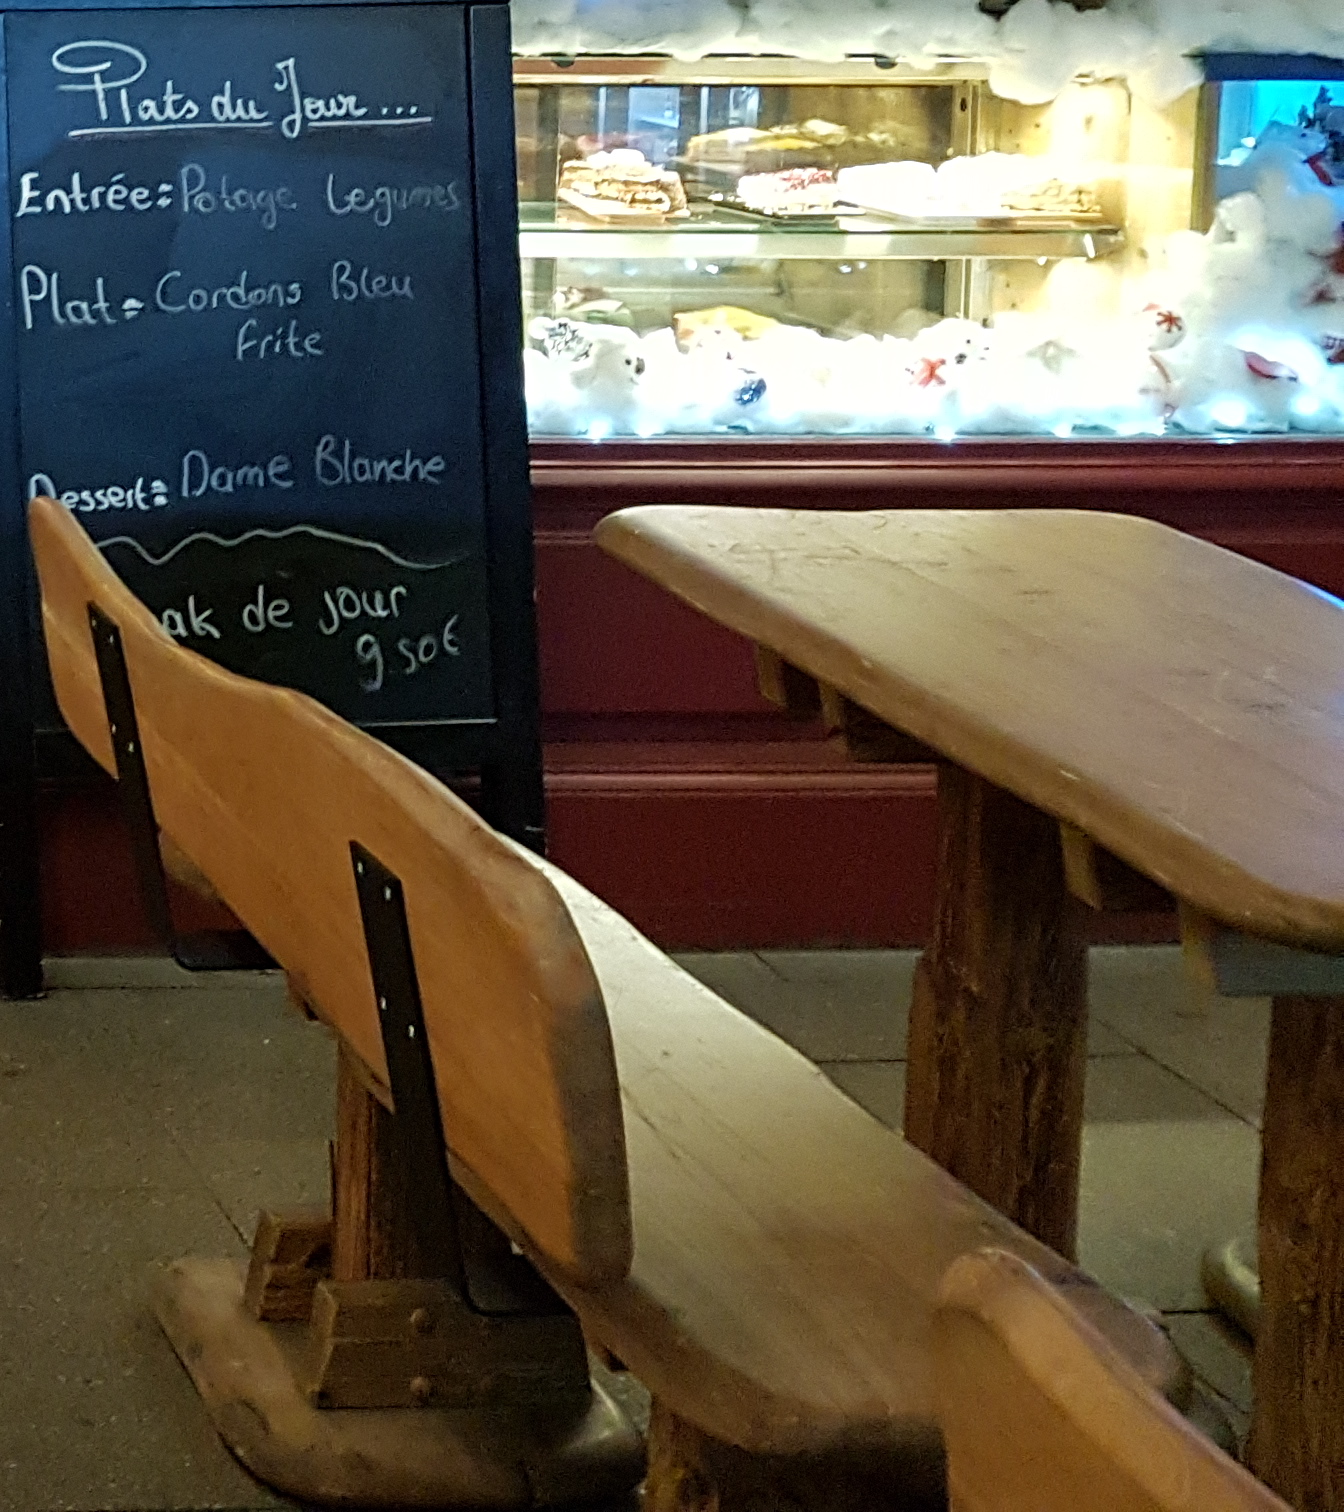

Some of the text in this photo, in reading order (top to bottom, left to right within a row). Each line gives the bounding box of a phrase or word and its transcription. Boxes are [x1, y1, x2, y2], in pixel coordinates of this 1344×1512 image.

[52, 40, 201, 124] Plats
[212, 81, 269, 120] du
[180, 163, 298, 231] Potage
[155, 270, 302, 312] Cordons
[330, 260, 413, 301] Bleu
[182, 450, 294, 498] Dame
[315, 435, 447, 486] Blanche
[242, 584, 293, 633] de
